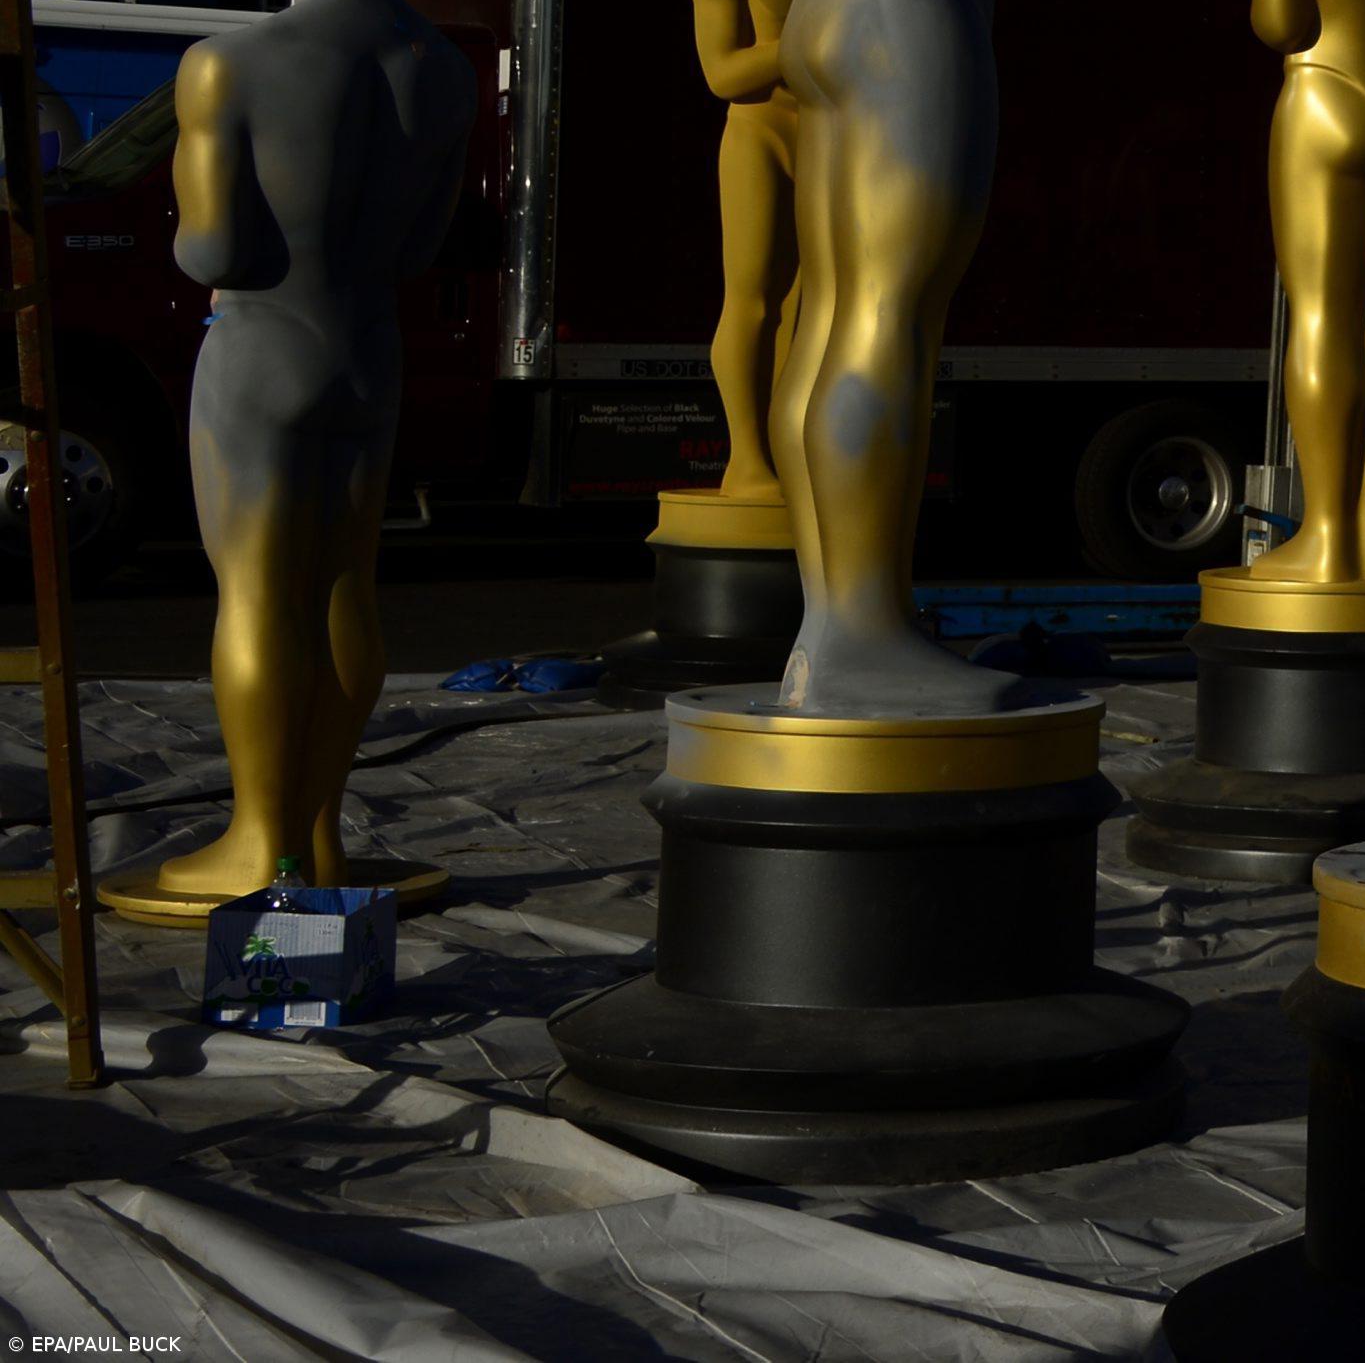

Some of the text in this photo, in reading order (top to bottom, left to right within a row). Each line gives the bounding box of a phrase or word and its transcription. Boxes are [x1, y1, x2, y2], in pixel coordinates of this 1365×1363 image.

[516, 345, 532, 363] 15
[592, 404, 619, 415] Huge
[621, 404, 658, 413] Selection
[674, 403, 700, 413] Black
[646, 414, 684, 423] Colored
